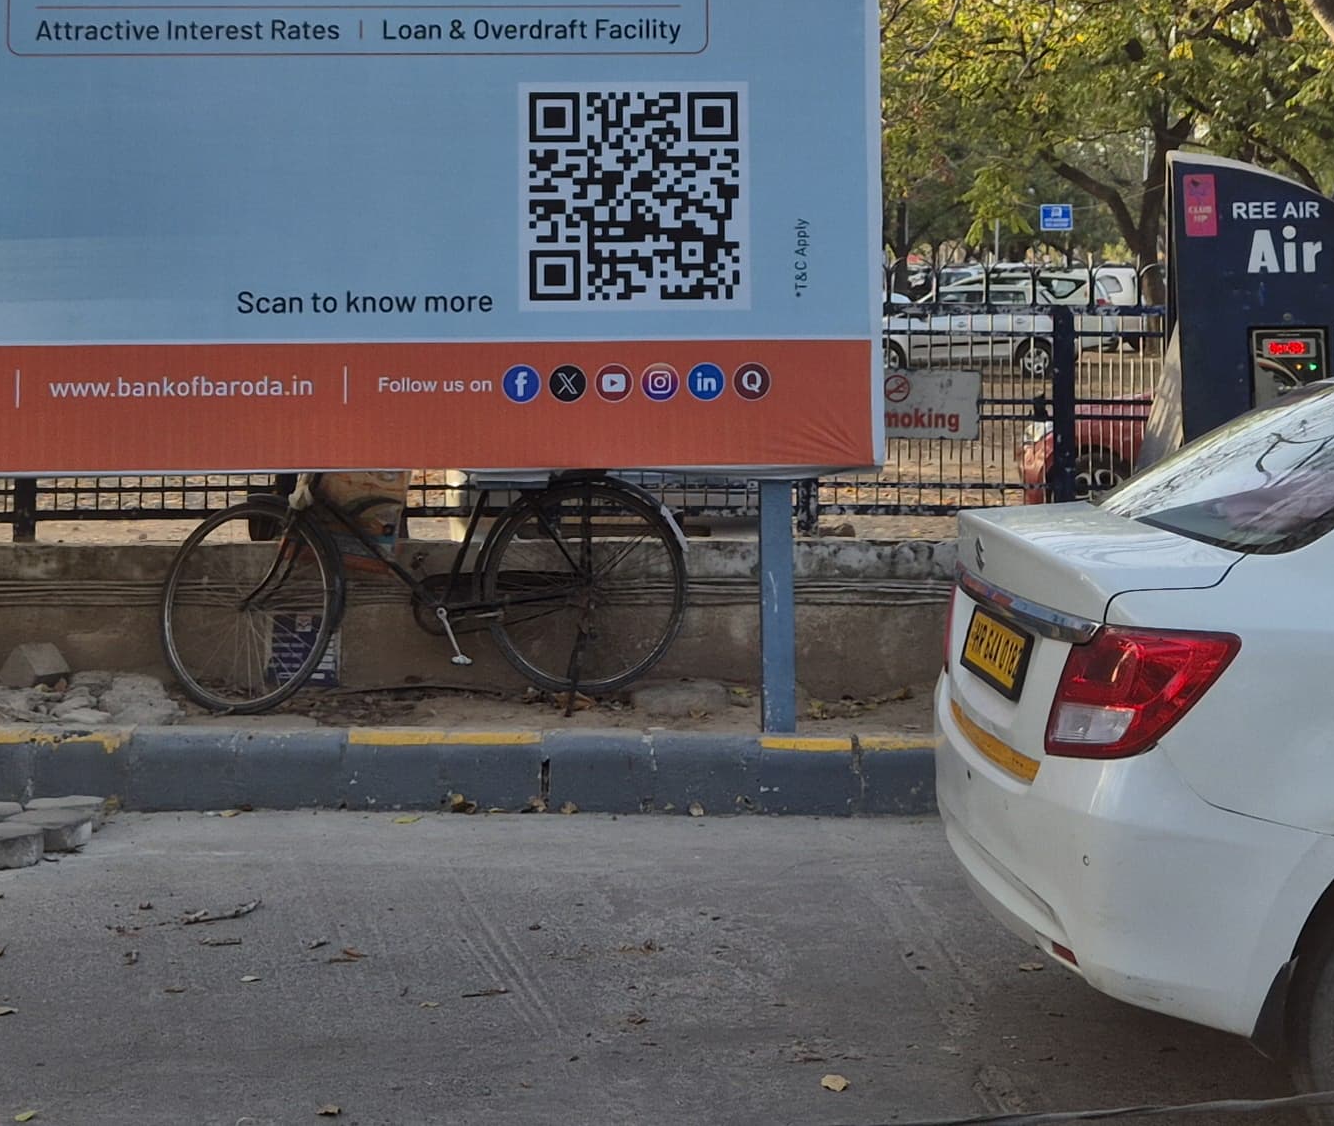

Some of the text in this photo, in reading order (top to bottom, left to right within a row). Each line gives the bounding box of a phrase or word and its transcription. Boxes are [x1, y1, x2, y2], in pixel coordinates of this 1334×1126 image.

[36, 19, 339, 41] Attractive Interest Rates
[383, 19, 680, 44] Loan & Overdraft Facility
[1233, 202, 1319, 219] REE AIR
[795, 219, 809, 256] Apply
[1248, 226, 1322, 273] Air
[238, 291, 492, 314] Scan to know more
[50, 376, 312, 397] www.bankofbaroda.in
[379, 377, 492, 392] Follow us on
[884, 408, 960, 433] moking
